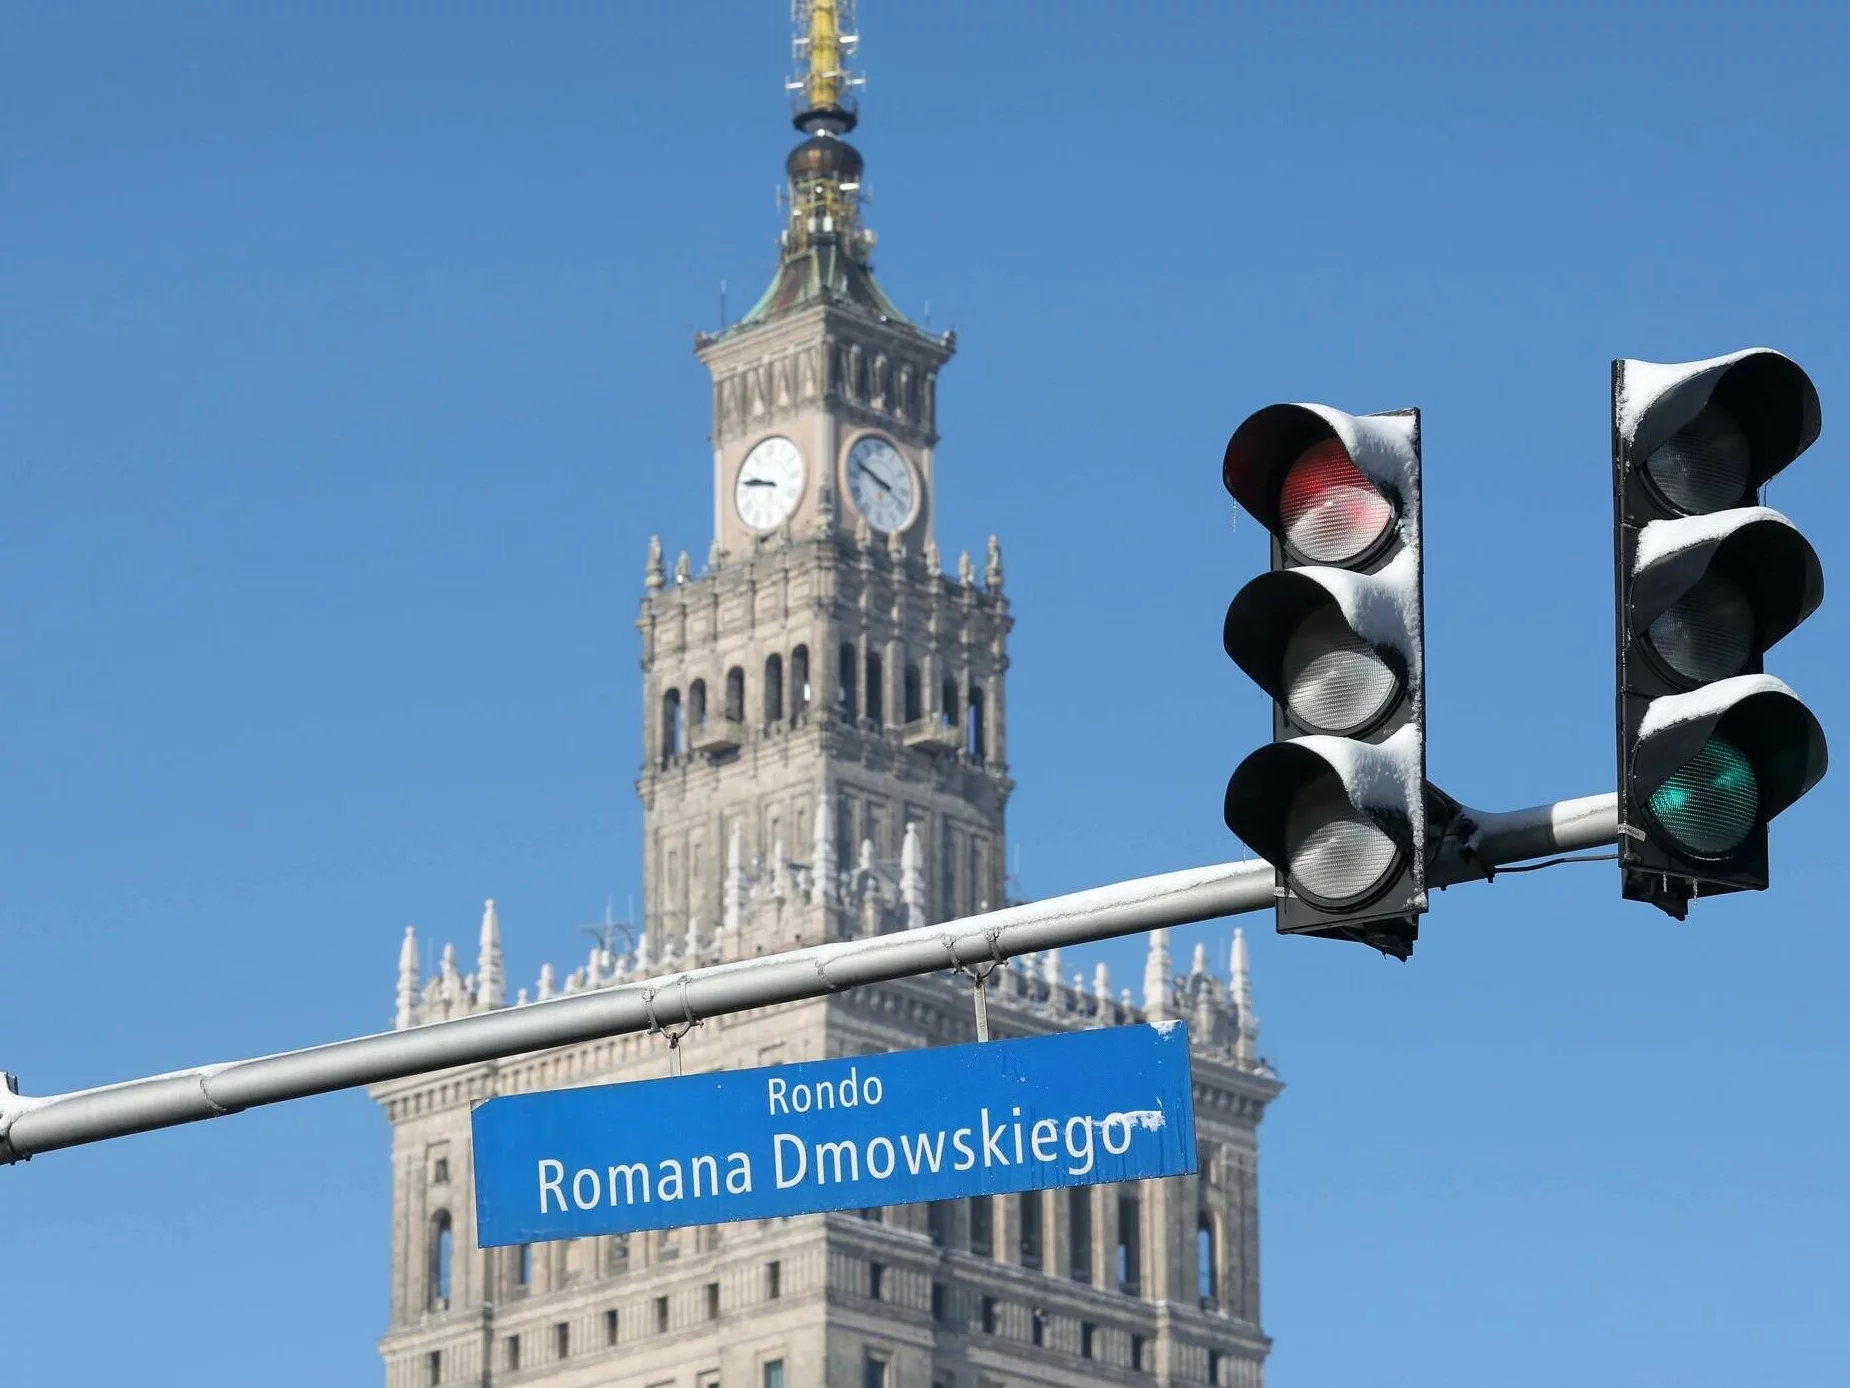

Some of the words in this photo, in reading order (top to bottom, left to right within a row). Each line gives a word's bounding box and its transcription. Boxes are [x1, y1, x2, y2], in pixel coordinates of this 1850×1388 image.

[768, 1066, 883, 1115] Rondo
[538, 1152, 752, 1214] Romana
[774, 1107, 1132, 1189] Dmowskiego
